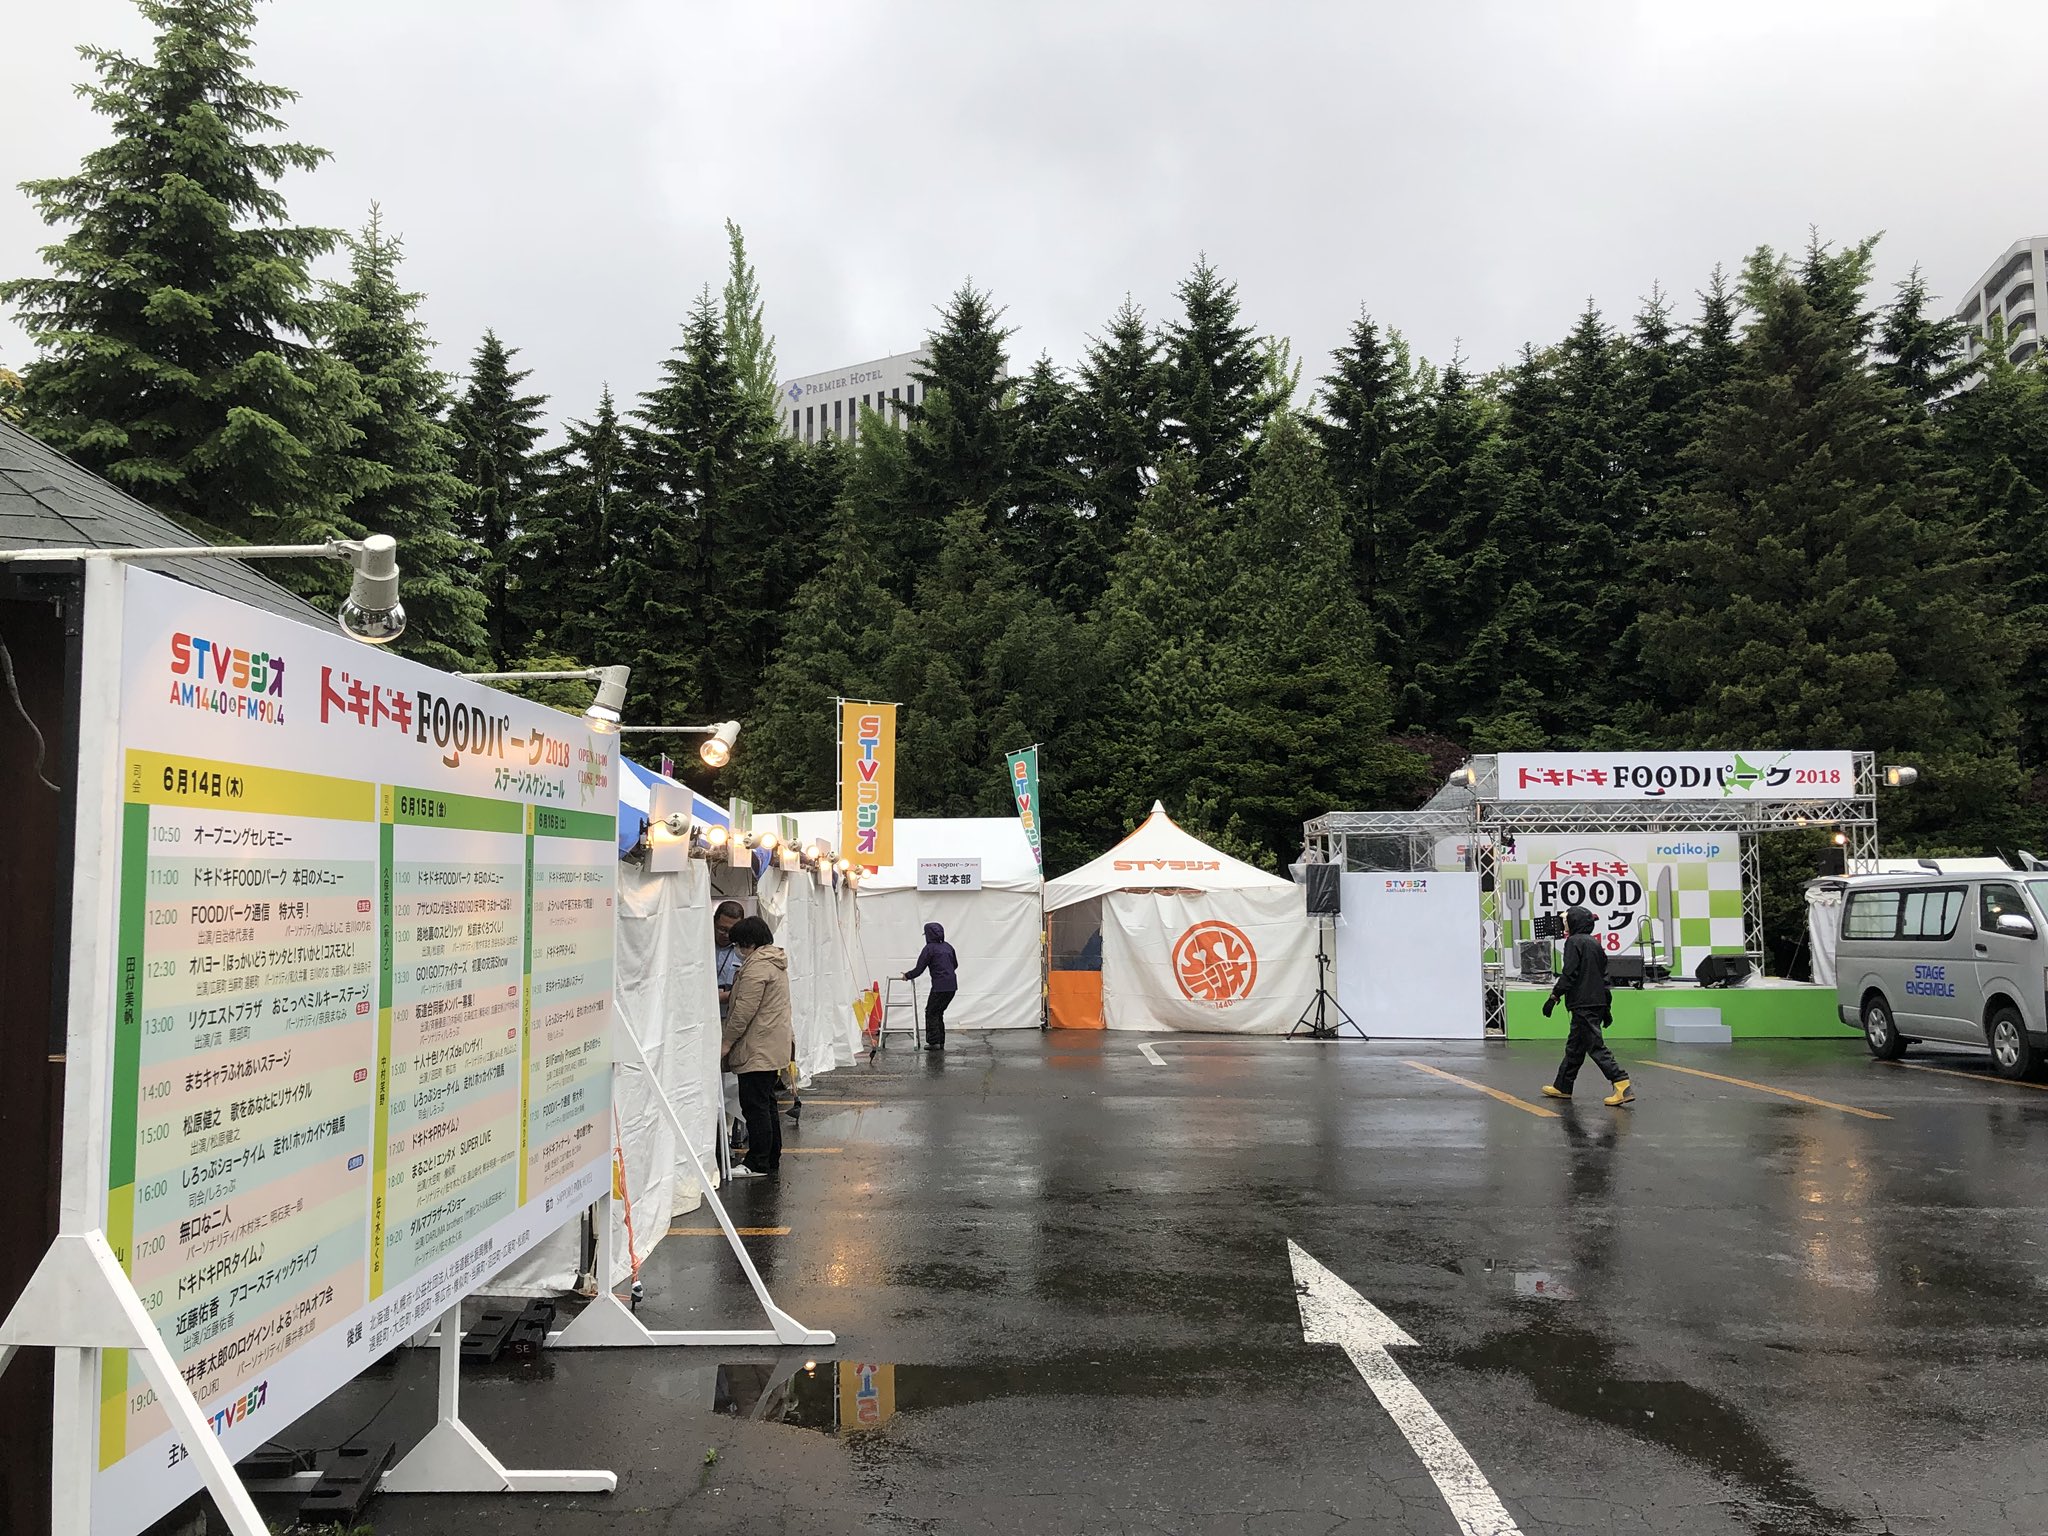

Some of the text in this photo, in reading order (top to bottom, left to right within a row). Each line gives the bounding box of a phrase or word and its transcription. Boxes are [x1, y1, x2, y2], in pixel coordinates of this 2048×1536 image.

[806, 370, 883, 395] PREMIER HOTEL
[171, 632, 285, 698] STVラジオ
[546, 738, 570, 768] 2018
[494, 767, 565, 800] ステージスケジュール
[857, 715, 880, 854] STVラジオ
[1795, 769, 1841, 785] 2018
[151, 825, 180, 843] 10:50
[193, 825, 292, 848] オープニングセレモニー
[1657, 843, 1720, 858] radiko.jp
[149, 869, 179, 885] 11:00
[192, 868, 343, 886] ドキドキFOODパーク 本日のメニュー
[417, 870, 503, 884] ドキドキFOODパーク 本日のメニュー
[1113, 860, 1221, 871] STVラジオ
[1550, 861, 1629, 880] ドキドキ
[927, 874, 971, 885] 運営本部
[1539, 880, 1642, 907] FOOD
[148, 909, 177, 925] 12:00
[191, 903, 269, 925] FOODパーク通信
[146, 960, 175, 979] 12:30
[1915, 965, 1945, 981] STAGE
[1906, 981, 1956, 998] ENSEMBLE
[144, 1015, 173, 1035] 13:00
[187, 1000, 262, 1030] リクエストプラザ
[185, 1049, 291, 1092] まちキャラふれあいステージ
[141, 1080, 171, 1103] 14:00
[183, 1080, 312, 1137] 松原健之 歌をあなたにリサイタル
[139, 1122, 169, 1146] 15:00
[460, 1135, 478, 1156] SUPER
[479, 1129, 491, 1146] LIVE
[181, 1143, 265, 1190] しろっぷショータイム
[137, 1179, 167, 1205] 16:00
[179, 1202, 231, 1245] 無口な二人
[135, 1234, 165, 1262] 17:00
[140, 1290, 163, 1312] 7:30
[176, 1295, 219, 1337] 近藤佑香
[229, 1245, 317, 1307] アコースティックライブ
[515, 1344, 530, 1354] SE
